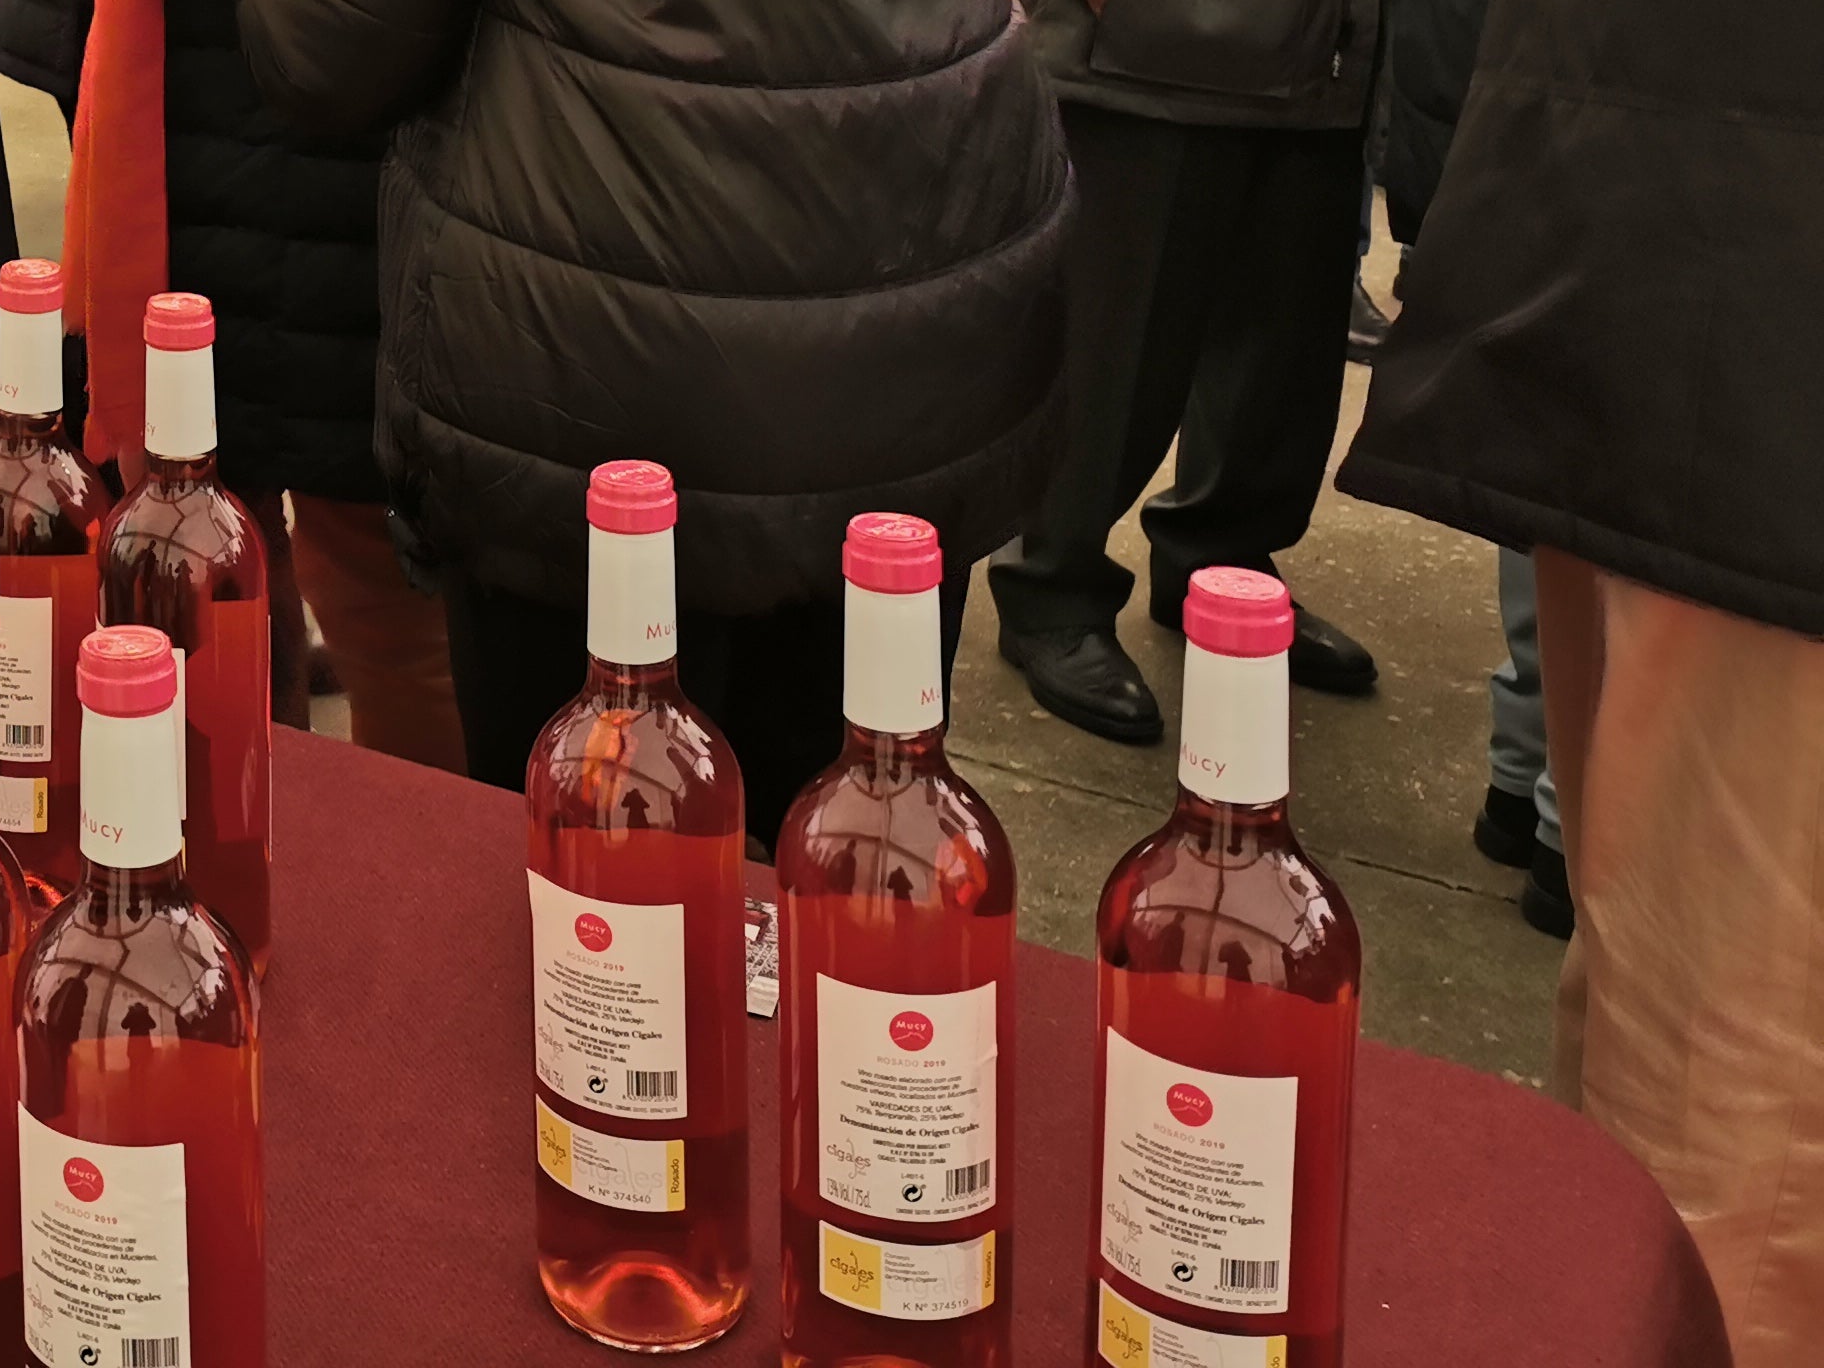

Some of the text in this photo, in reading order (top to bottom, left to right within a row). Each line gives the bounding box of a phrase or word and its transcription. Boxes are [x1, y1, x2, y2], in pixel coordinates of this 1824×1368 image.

[646, 621, 676, 640] Muc
[36, 792, 44, 819] Rosado
[580, 921, 606, 935] Mucy
[589, 1023, 599, 1031] de
[600, 1025, 629, 1038] Origen
[632, 1031, 662, 1040] Cigales
[896, 1021, 927, 1031] Mucy
[877, 1055, 946, 1068] ROSADO 2019
[869, 1099, 920, 1112] VARIEDADES
[922, 1105, 934, 1113] DE
[1173, 1091, 1205, 1108] Mucy
[839, 1114, 903, 1136] Denominación
[905, 1128, 917, 1137] de
[918, 1128, 950, 1138] Origen
[1199, 1138, 1225, 1150] 2019
[826, 1140, 871, 1174] cigales
[69, 1166, 97, 1182] Mucy
[671, 1159, 679, 1193] Rosado
[588, 1185, 595, 1193] K
[614, 1192, 651, 1204] 374540
[1196, 1185, 1209, 1195] DE
[1178, 1204, 1190, 1214] de
[1192, 1207, 1227, 1222] Origen
[1229, 1214, 1265, 1226] Cigales
[94, 1263, 105, 1272] DE
[830, 1251, 874, 1288] cigales
[80, 1284, 90, 1294] de
[93, 1287, 124, 1301] Origen
[127, 1292, 161, 1303] Cigales
[903, 1302, 911, 1311] K
[931, 1298, 969, 1312] 374519
